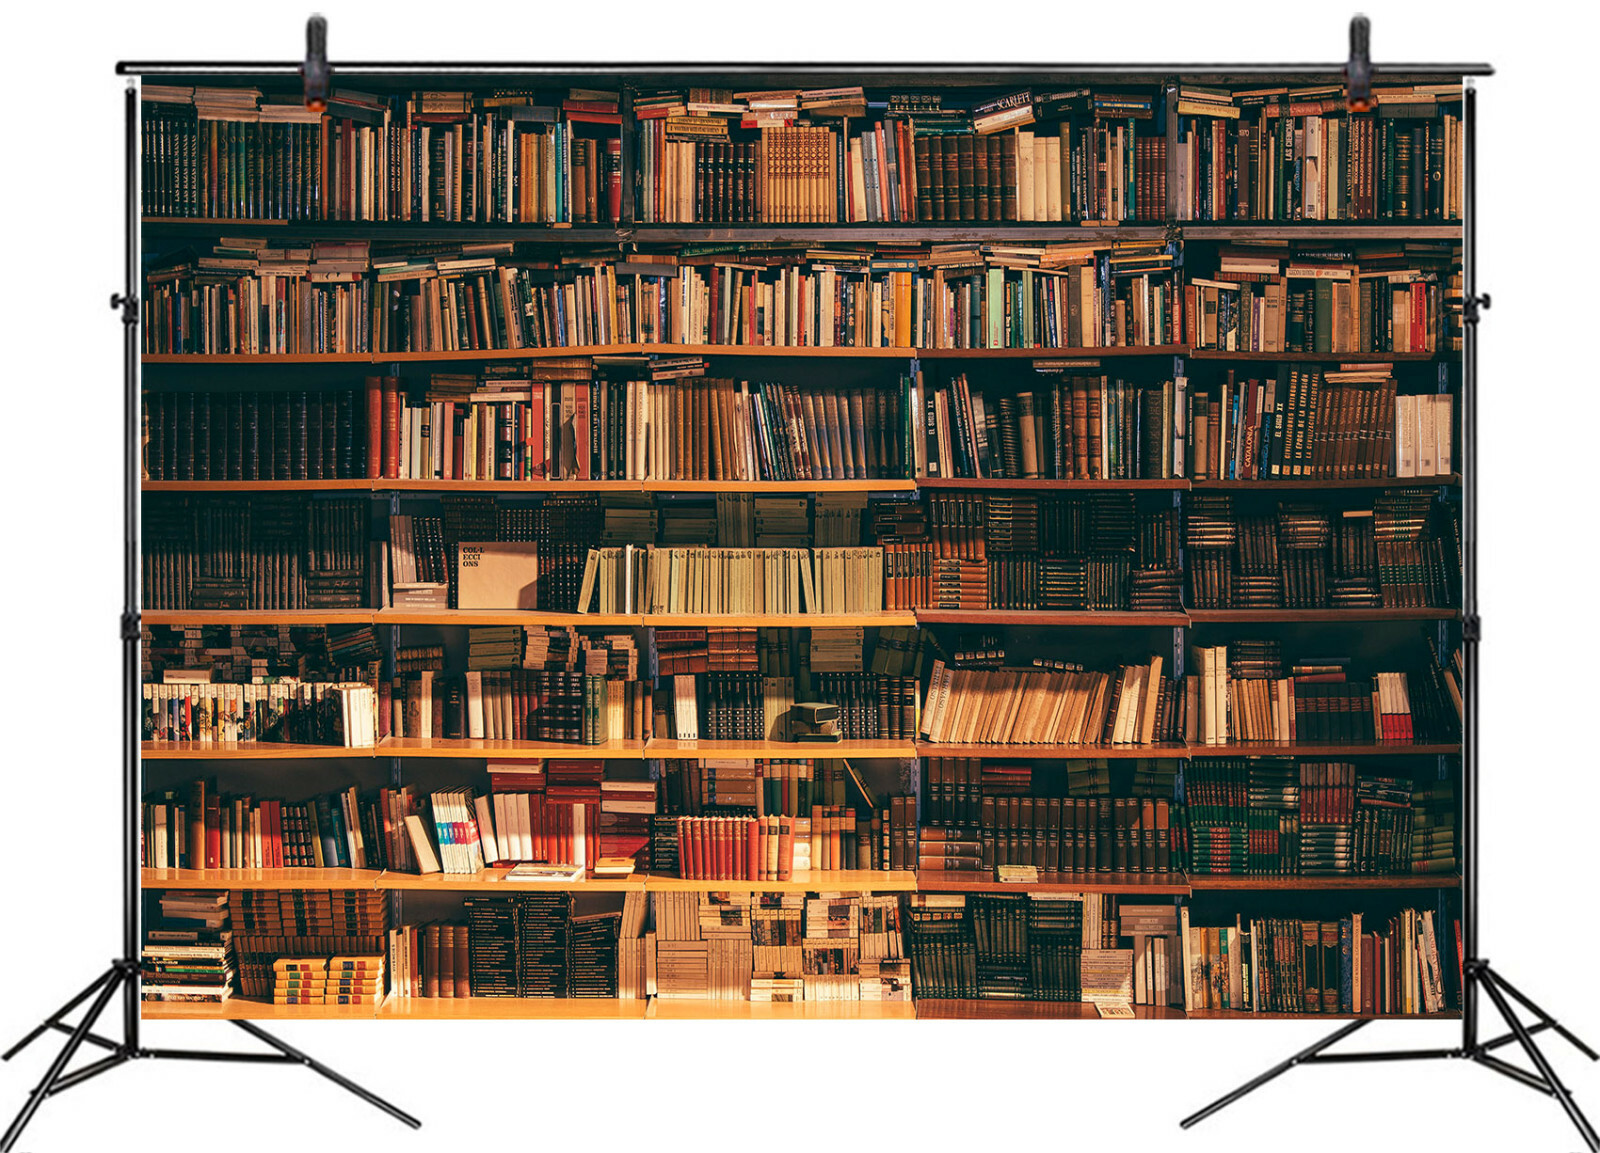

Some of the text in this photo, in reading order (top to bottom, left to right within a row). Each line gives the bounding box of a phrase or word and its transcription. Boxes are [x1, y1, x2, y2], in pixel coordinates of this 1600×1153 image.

[997, 91, 1031, 110] SCARLETT
[1285, 118, 1293, 161] LAS CIENCIAS
[927, 400, 934, 408] XX
[1276, 402, 1284, 412] XX
[1275, 414, 1283, 430] SIGLO
[1284, 371, 1298, 459] CIVILIZACIONES EXTINGUIDAS
[1305, 451, 1312, 459] LA
[1309, 373, 1319, 409] OCCIDENTAL
[1297, 420, 1305, 428] DE
[1244, 425, 1254, 467] CATALONIA
[1295, 451, 1302, 459] LA
